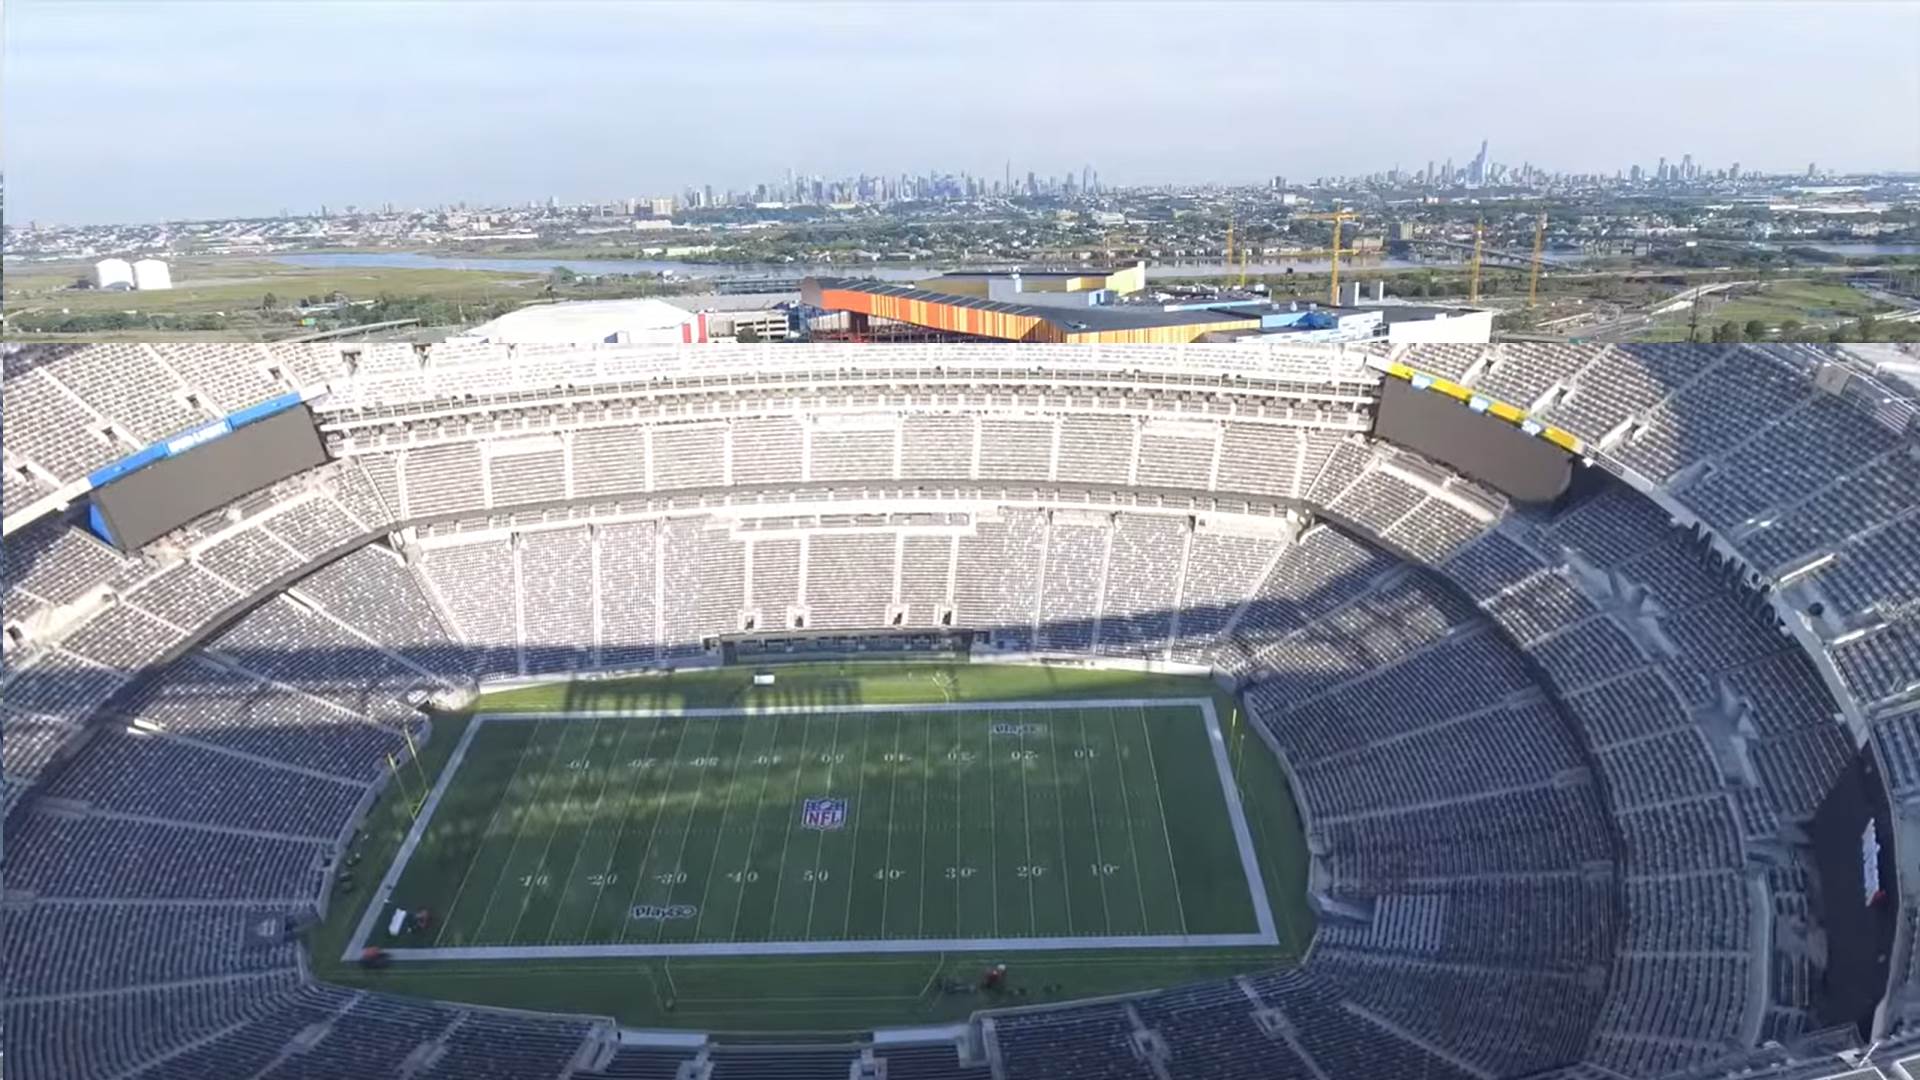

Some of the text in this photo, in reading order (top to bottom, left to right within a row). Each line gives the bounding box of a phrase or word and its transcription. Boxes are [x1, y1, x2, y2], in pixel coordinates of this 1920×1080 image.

[808, 810, 844, 826] NFL
[803, 870, 829, 881] 50
[873, 868, 900, 880] 40
[944, 867, 972, 878] 30
[1017, 865, 1043, 877] 20
[1091, 864, 1114, 876] 10
[523, 874, 548, 887] 10
[591, 873, 618, 886] 20
[661, 872, 687, 885] 30
[733, 871, 759, 882] 40
